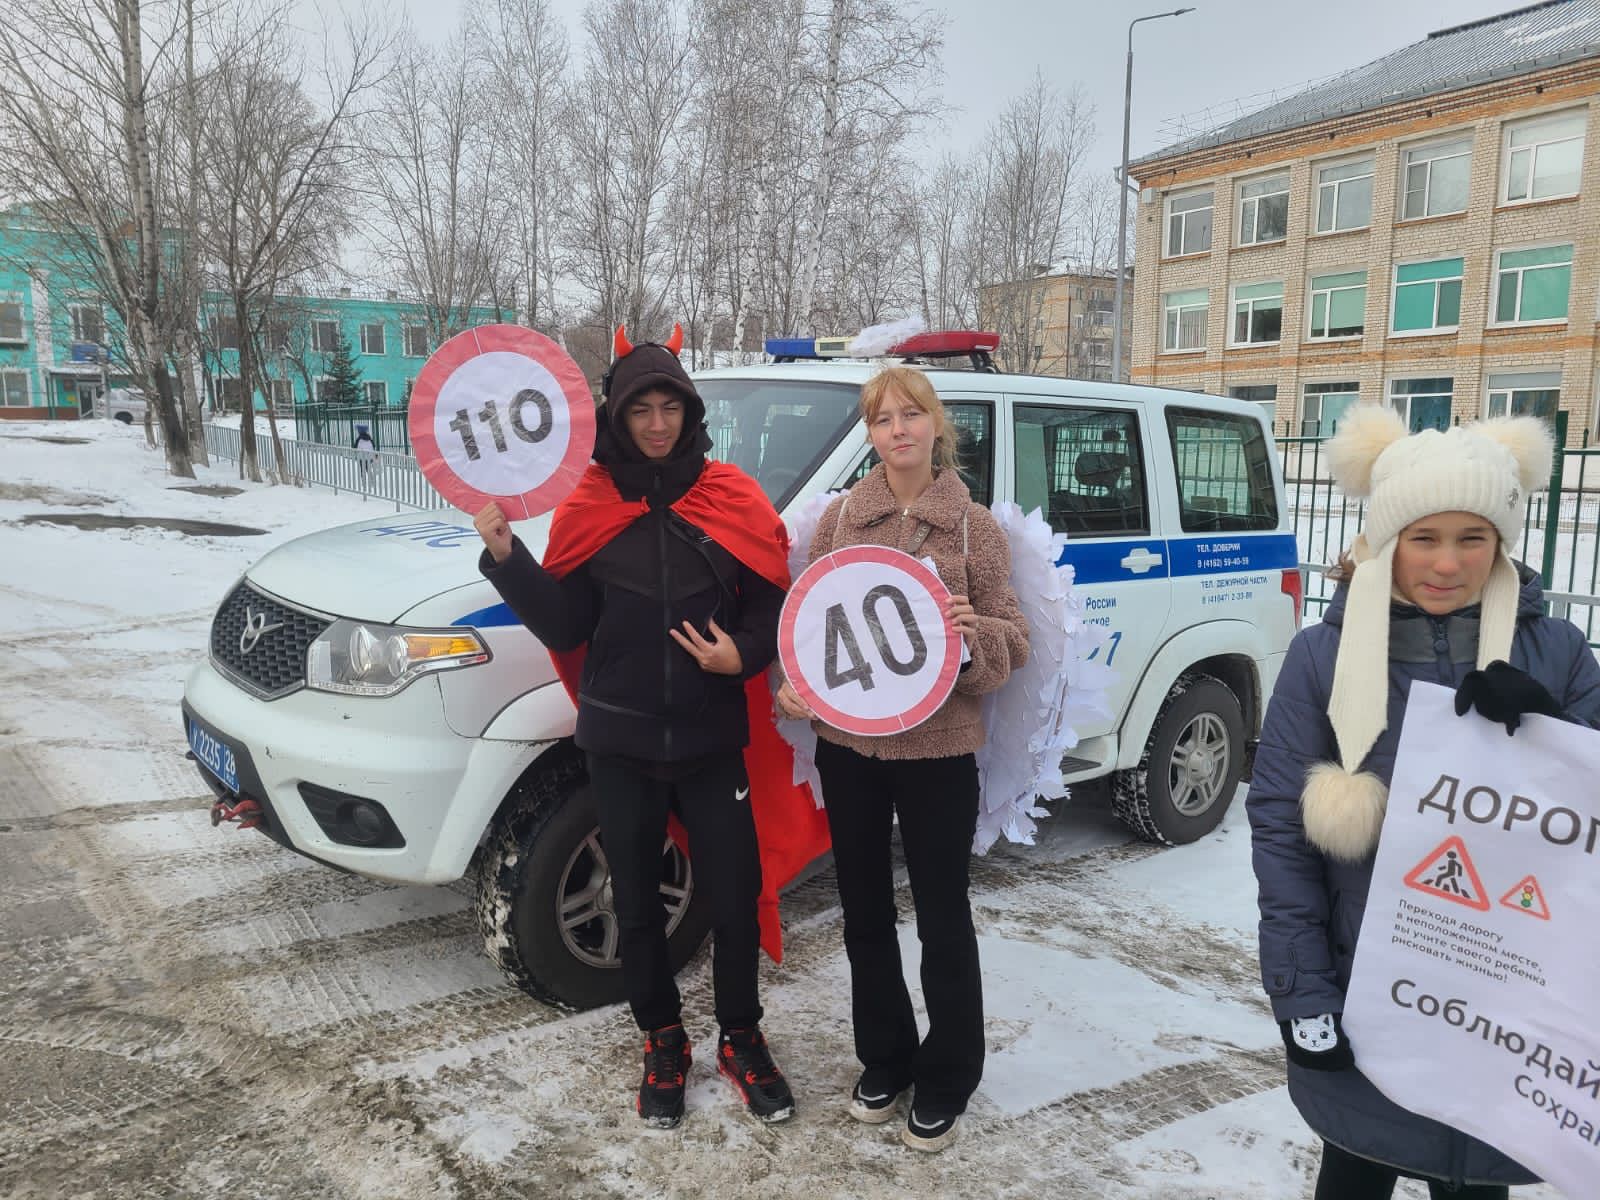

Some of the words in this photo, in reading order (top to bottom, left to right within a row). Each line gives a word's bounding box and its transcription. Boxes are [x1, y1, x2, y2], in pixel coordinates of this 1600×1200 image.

[449, 388, 554, 463] 110
[1249, 576, 1268, 585] ЧАСТИ
[823, 584, 929, 693] 40
[199, 729, 221, 772] 2235
[1399, 898, 1457, 926] Переходя
[1459, 922, 1504, 943] дорогу
[1406, 916, 1498, 953] неположенном
[1501, 950, 1542, 972] месте,
[1391, 934, 1452, 961] рисковать
[1455, 957, 1508, 982] жизнью!
[1394, 924, 1410, 934] вы
[1413, 929, 1447, 947] учите
[1450, 943, 1492, 964] своего
[1494, 959, 1546, 987] ребенка
[1391, 978, 1600, 1099] Соблюдай
